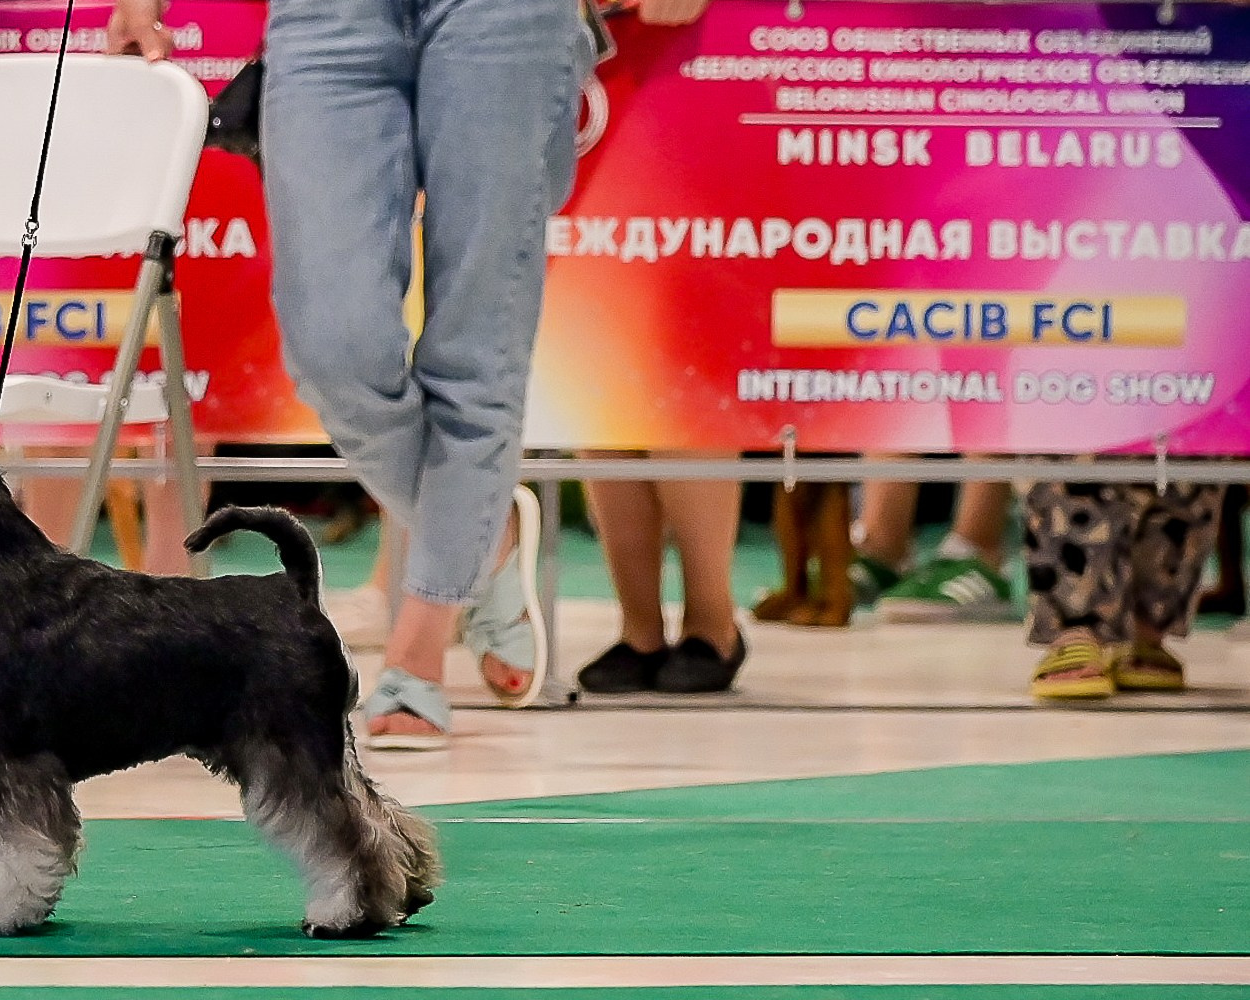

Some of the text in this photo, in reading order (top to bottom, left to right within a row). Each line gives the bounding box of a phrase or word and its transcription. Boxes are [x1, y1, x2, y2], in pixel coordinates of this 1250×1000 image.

[749, 27, 829, 52] СОЮЗ
[831, 27, 1031, 54] ОБЩЕСТВЕННЫХ
[1106, 88, 1186, 114] UNION
[777, 129, 1183, 167] MINSK BELARUS
[546, 215, 1250, 263] ЕЖДУНАРОДНАЯ ВЫСТАВКА
[26, 302, 105, 340] FCI
[845, 300, 1113, 341] CACIB FCI
[737, 367, 1215, 405] INTERNATIONAL DOG SHOW
